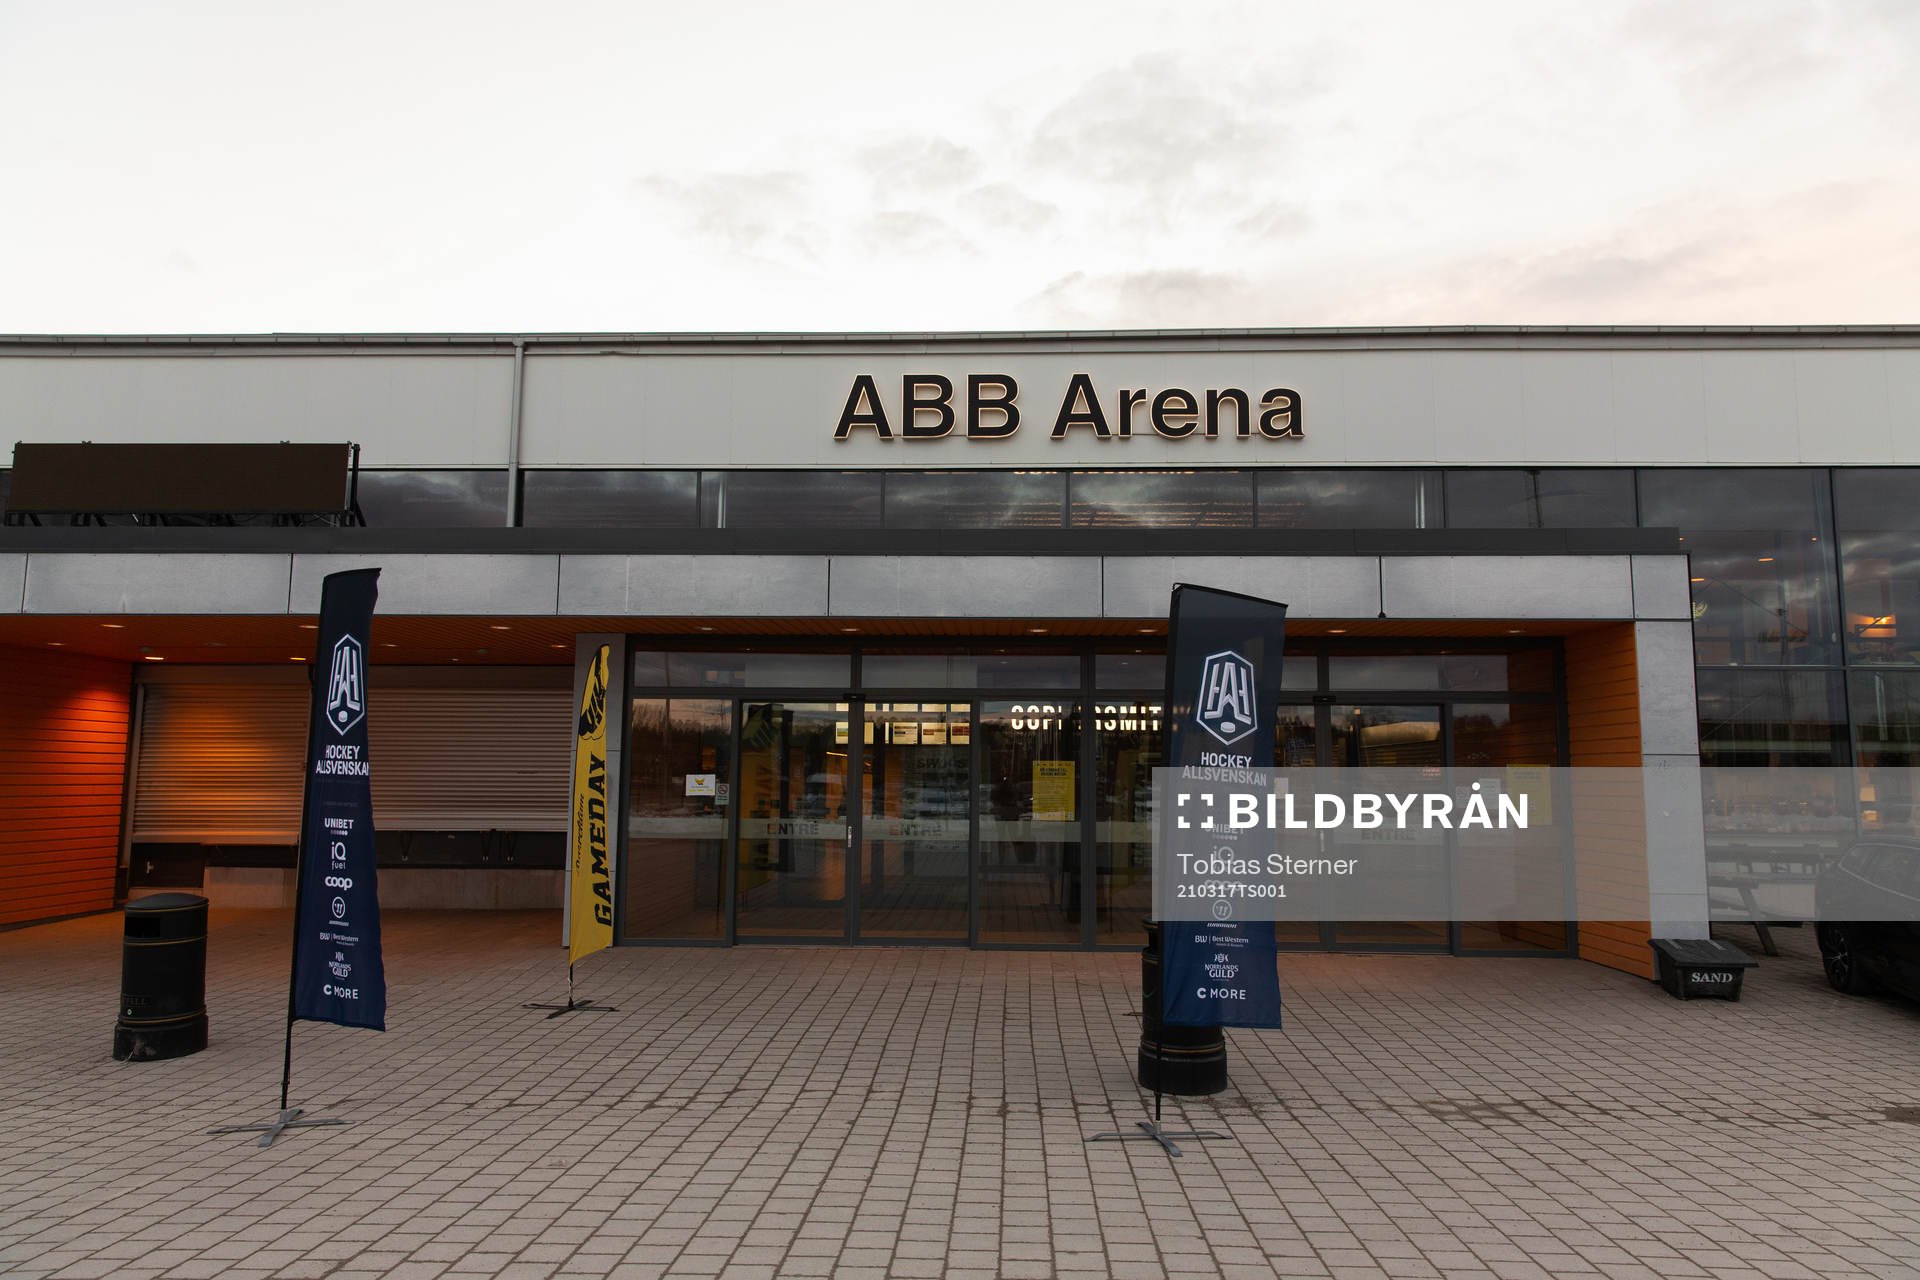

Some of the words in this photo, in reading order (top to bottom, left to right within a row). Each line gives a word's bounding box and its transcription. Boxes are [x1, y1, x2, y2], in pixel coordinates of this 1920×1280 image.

[833, 373, 1022, 439] ABB
[1050, 373, 1306, 439] Arena
[325, 744, 360, 760] HOCKEY
[1201, 751, 1252, 769] HOCKEY
[1182, 765, 1267, 787] ALLSVENSKAN
[324, 818, 354, 829] UNIBET
[588, 751, 612, 927] GAMEDAY
[324, 876, 353, 890] coop
[1225, 936, 1249, 944] Western
[1209, 969, 1235, 979] GULD
[1691, 972, 1733, 983] SAND
[334, 986, 359, 1000] MORE
[1210, 988, 1247, 1000] MORE
